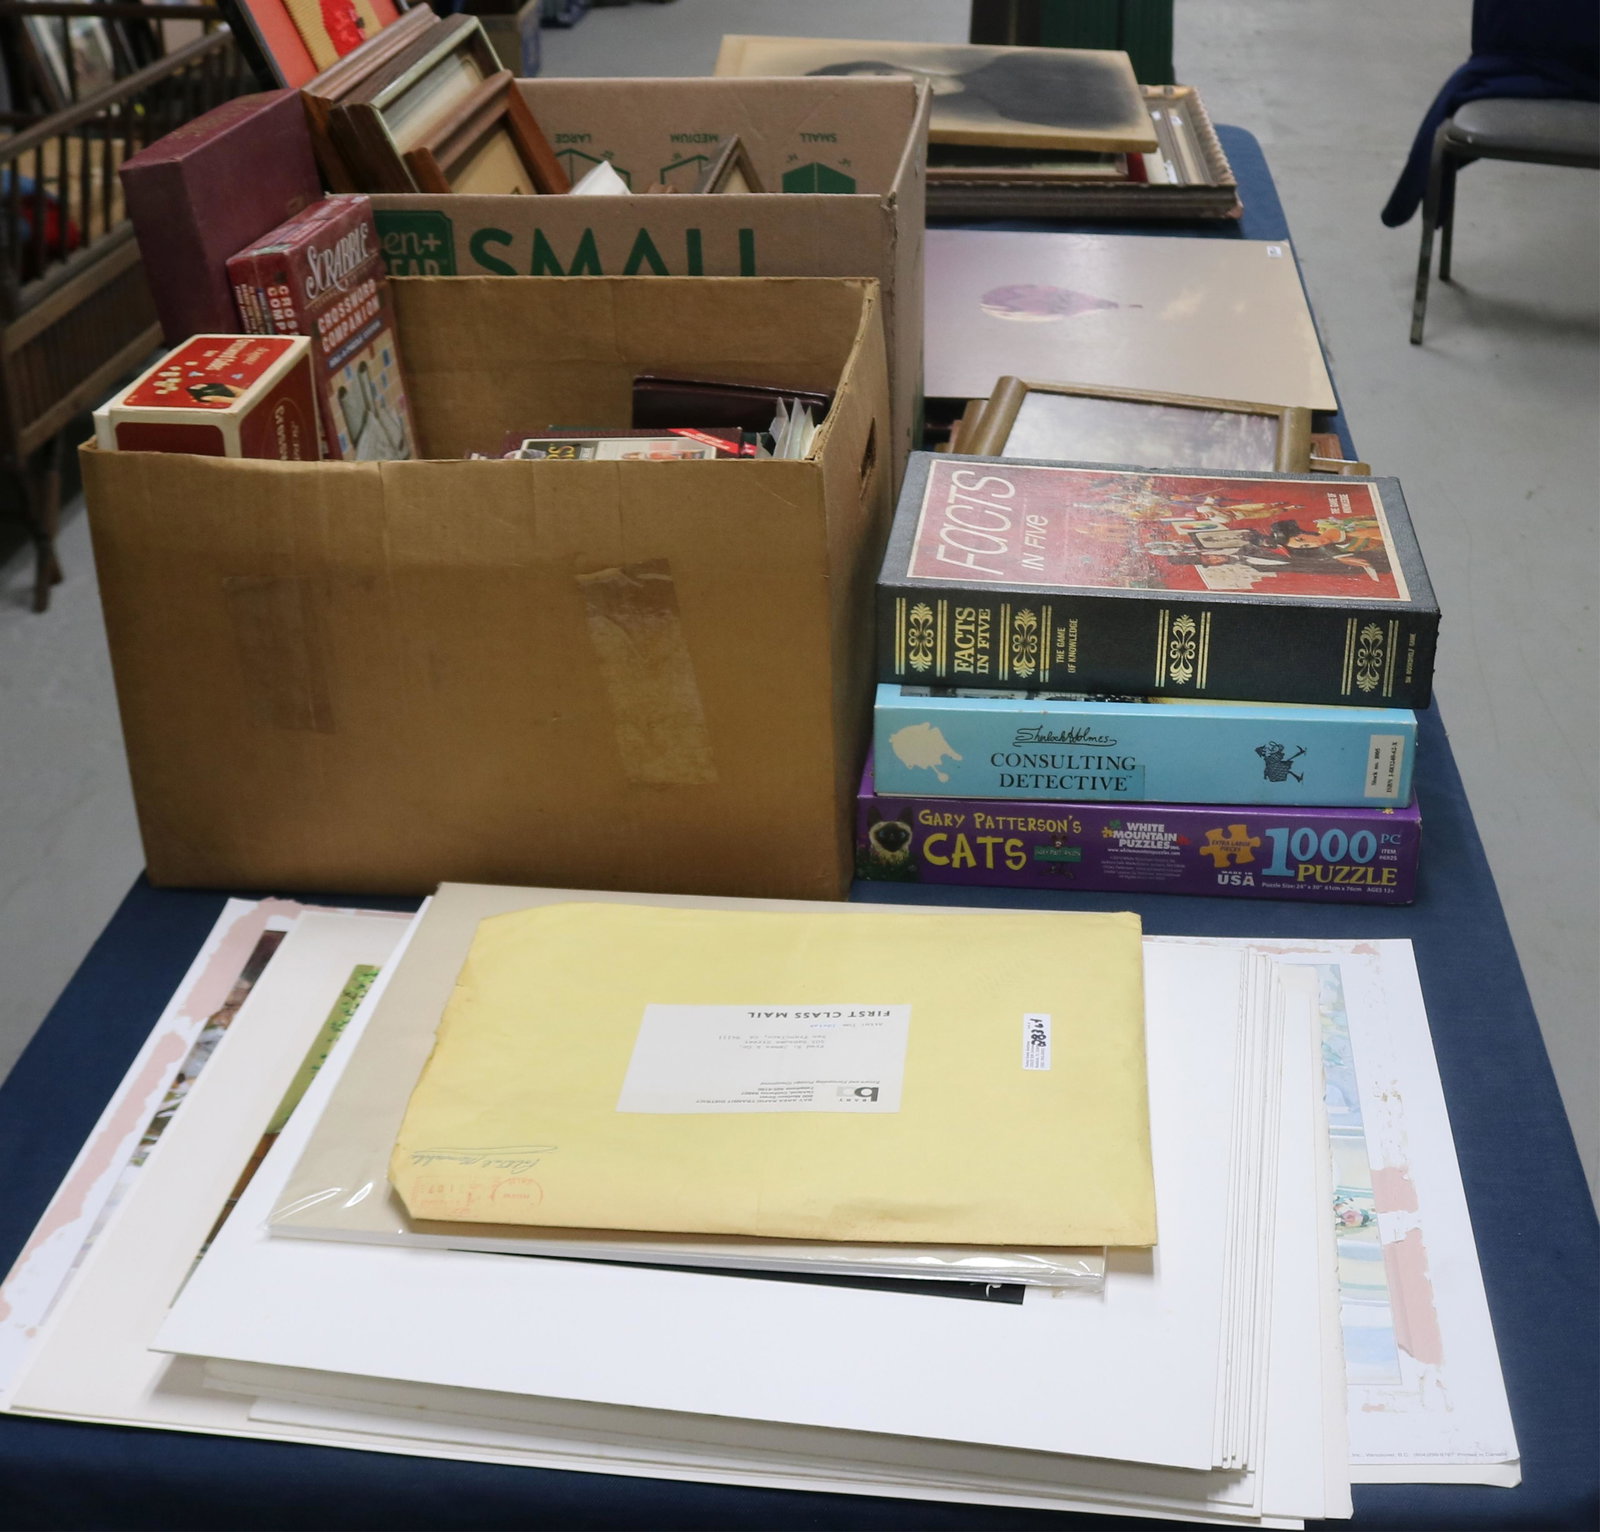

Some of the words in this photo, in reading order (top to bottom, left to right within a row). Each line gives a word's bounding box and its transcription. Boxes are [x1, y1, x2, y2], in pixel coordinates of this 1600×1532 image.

[555, 133, 591, 144] LARGE
[669, 133, 718, 144] MEDIUM
[800, 132, 836, 143] SMALL
[306, 222, 369, 300] SCRABBLE
[469, 227, 755, 276] SMALL
[278, 285, 300, 335] CROS
[318, 279, 376, 334] CROSSWORD
[322, 295, 381, 353] COMPANION
[1021, 553, 1044, 571] IN
[977, 608, 991, 649] FIVE
[1056, 627, 1066, 649] GAME
[954, 607, 976, 674] FACTS
[1068, 618, 1079, 664] KNOWLEDGE
[977, 654, 989, 674] IN
[1056, 650, 1065, 664] THE
[1067, 664, 1076, 674] OF
[1014, 724, 1066, 743] Sherlock
[991, 752, 1136, 771] CONSULTING
[1000, 773, 1128, 791] DETECTIVE
[918, 809, 965, 828] GARY
[974, 812, 1082, 834] PATTERSON'S
[1126, 822, 1165, 832] WHITE
[1113, 830, 1178, 842] MOUNTAIN
[1119, 839, 1170, 850] PUZZLES
[923, 833, 1027, 871] CATS
[1262, 827, 1377, 877] 1000
[1381, 833, 1401, 845] PC
[1217, 874, 1255, 886] USA
[1296, 864, 1397, 886] PUZZLE
[747, 1011, 789, 1019] MAIL
[795, 1011, 842, 1019] CLASS
[847, 1010, 890, 1018] FIRST
